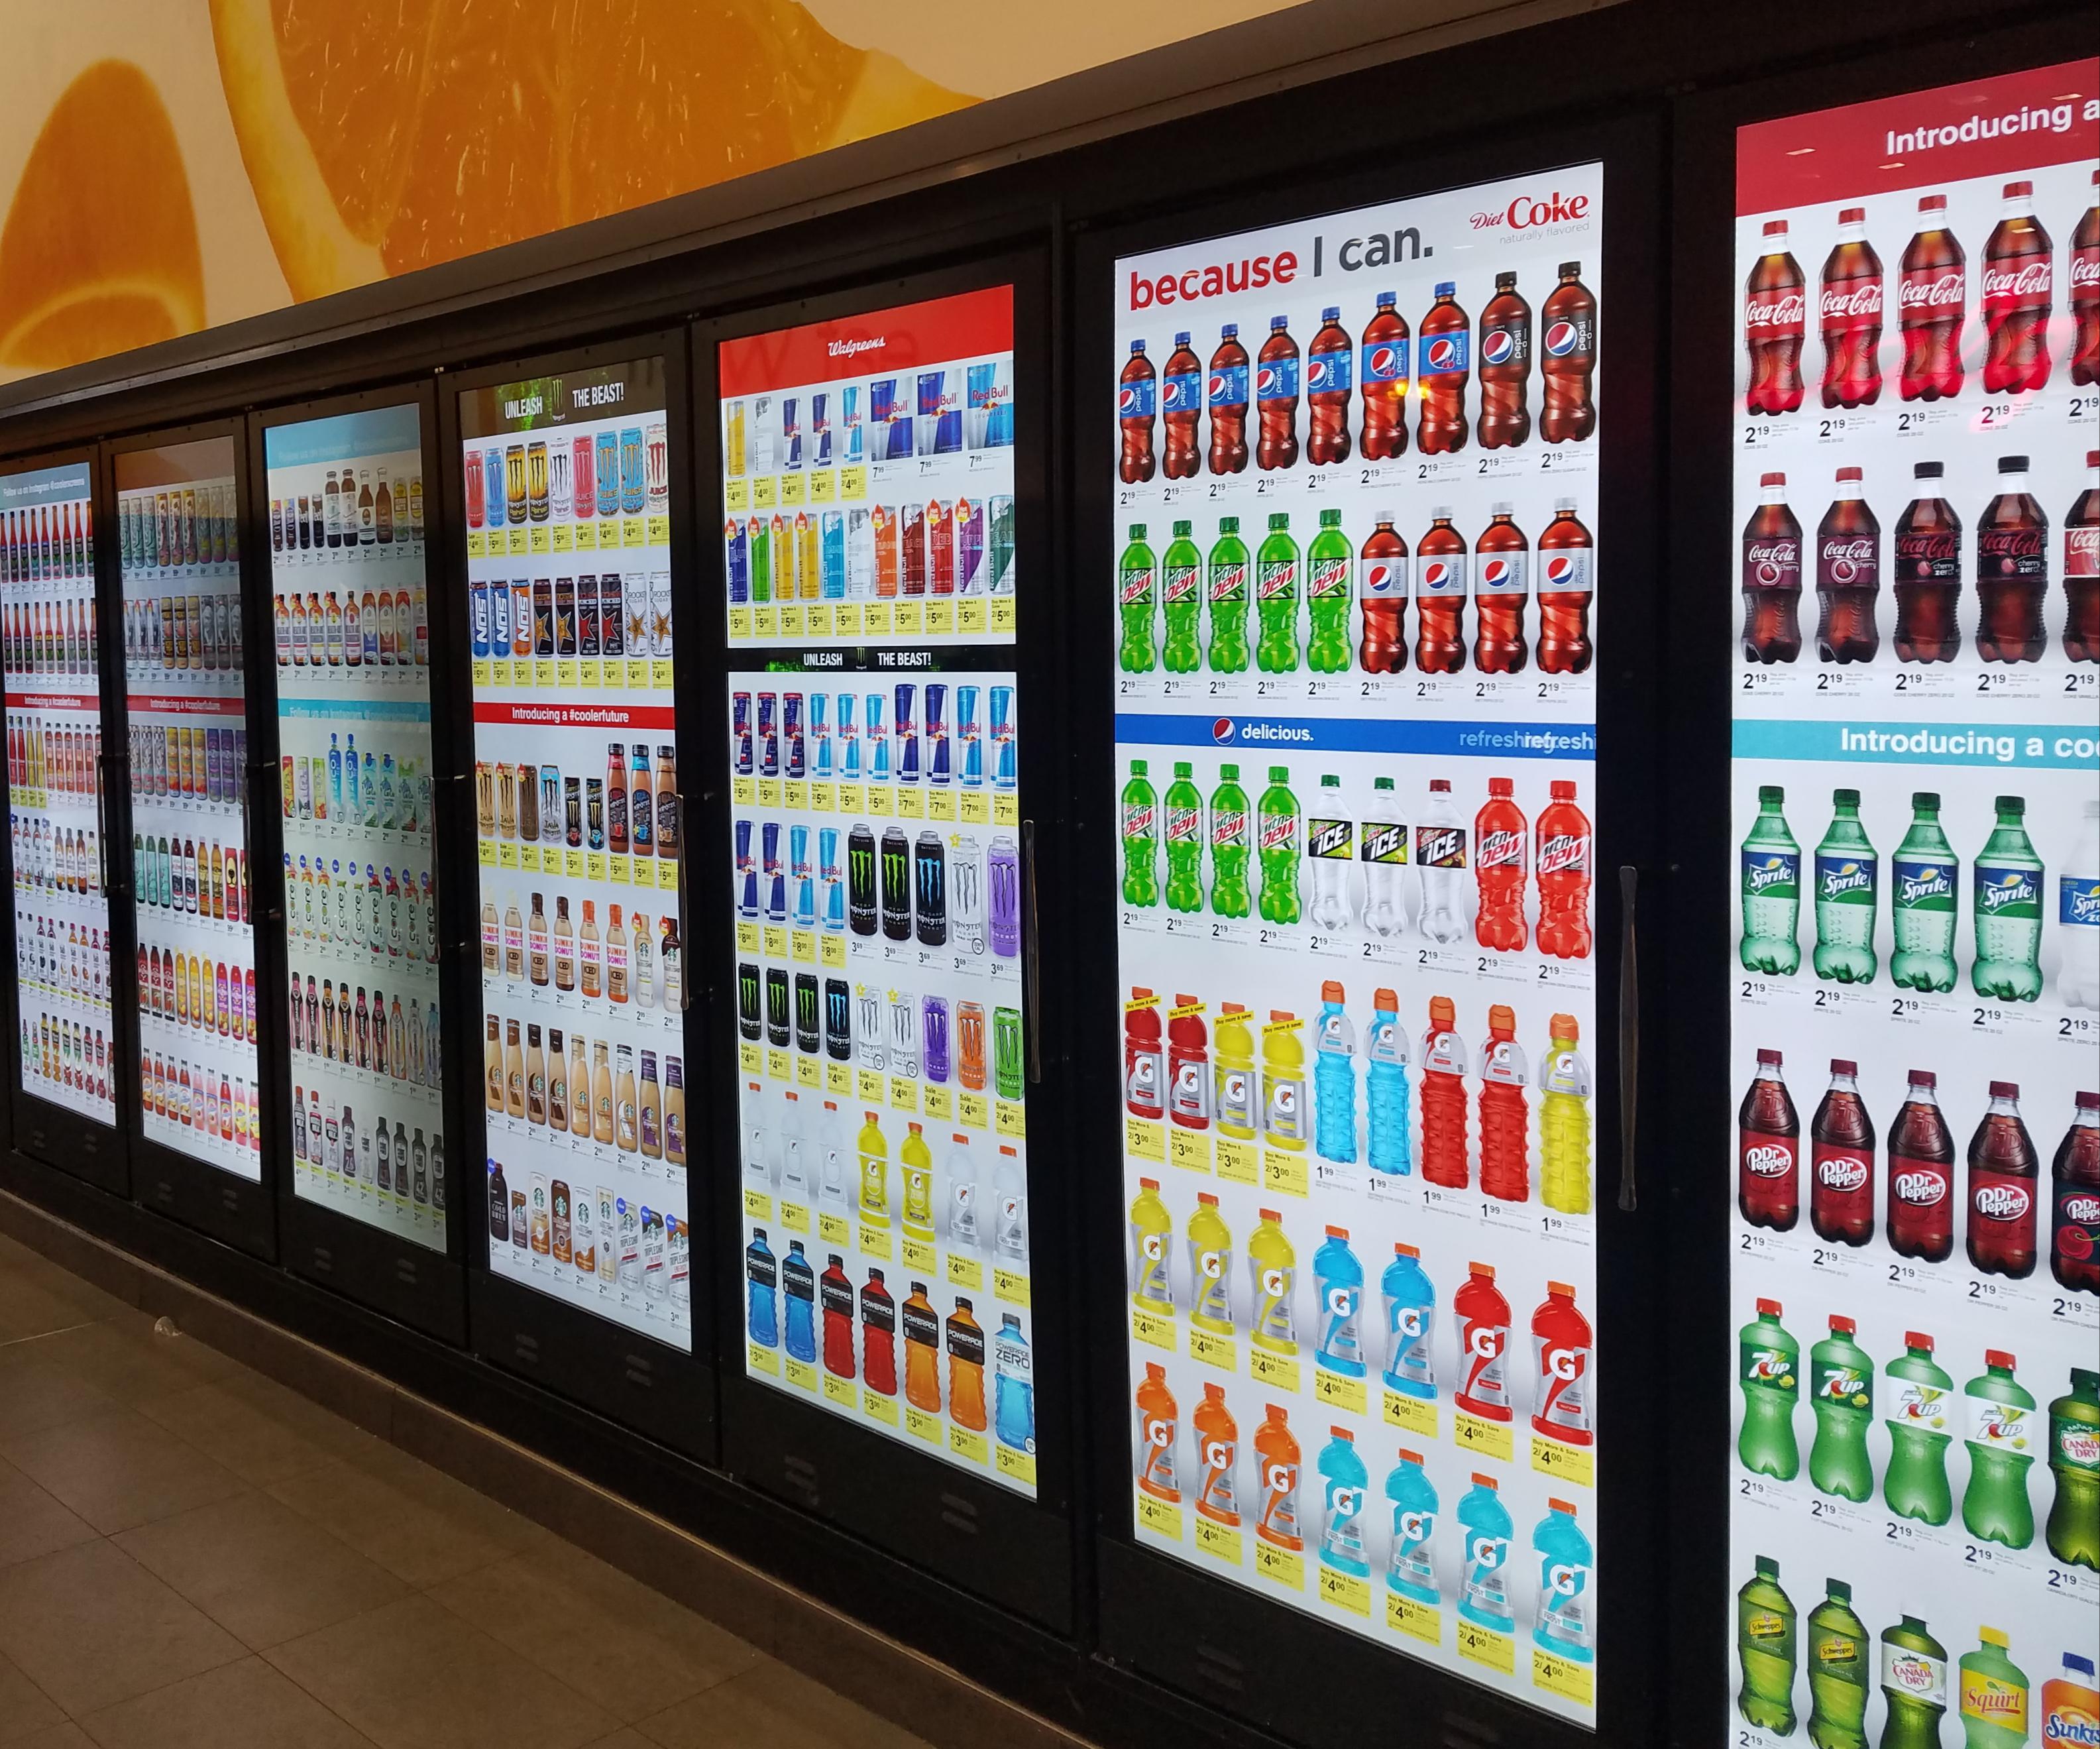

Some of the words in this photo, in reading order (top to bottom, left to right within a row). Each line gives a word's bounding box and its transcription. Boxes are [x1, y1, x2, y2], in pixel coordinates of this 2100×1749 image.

[1887, 103, 2073, 156] Introducing
[1470, 210, 1504, 230] Diet
[1507, 192, 1590, 229] Coke
[1500, 230, 1543, 245] naturally
[1546, 221, 1590, 237] flavored
[1131, 251, 1298, 311] because
[1313, 237, 1323, 277] I
[1339, 225, 1433, 272] can.
[1983, 262, 2051, 299] Coca-Cola
[1820, 285, 1881, 318] Coca-Cola
[1899, 274, 1963, 308] Coca-Cola
[1745, 295, 1804, 329] Coca-Cola
[828, 336, 885, 358] Walgreens
[505, 396, 543, 420] UNLEASH
[573, 389, 590, 408] THE
[592, 382, 624, 406] BEAST!
[973, 389, 989, 402] Red
[991, 385, 1008, 398] Bull
[804, 653, 842, 666] UNLEASH
[877, 653, 895, 665] THE
[898, 652, 931, 665] BEAST!
[512, 707, 560, 723] Introducing
[1242, 724, 1314, 741] delicious.
[1841, 728, 2015, 761] Introducing
[2026, 737, 2044, 753] a
[1317, 824, 1345, 855] ICE
[1370, 827, 1400, 859] ICE
[1427, 830, 1458, 864] ICE
[1751, 864, 1791, 888] Sprite
[1824, 870, 1867, 894] Sprite
[1903, 875, 1948, 900] Sprite
[1985, 881, 2033, 907] Sprite
[1135, 1056, 1153, 1083] G
[1274, 1085, 1294, 1113] G
[1747, 1148, 1789, 1173] Pepper
[1762, 1147, 1779, 1159] Dr
[1820, 1161, 1863, 1186] Pepper
[1836, 1160, 1853, 1173] Dr
[1897, 1175, 1942, 1200] Pepper
[1914, 1174, 1932, 1187] Dr
[1977, 1190, 2026, 1215] Pepper
[1995, 1188, 2014, 1201] Dr
[2083, 1199, 2099, 1210] Dr
[1471, 1327, 1495, 1358] G
[996, 1348, 1030, 1369] ZERO
[1549, 1349, 1575, 1380] G
[1149, 1420, 1168, 1447] G
[2075, 1449, 2097, 1457] DRY
[1550, 1564, 1574, 1595] G
[1751, 1622, 1781, 1632] Schweppes
[1822, 1645, 1853, 1656] Schweppes
[1893, 1665, 1934, 1679] CANADA
[1905, 1674, 1926, 1685] DRY
[1968, 1687, 2019, 1711] Squirt
